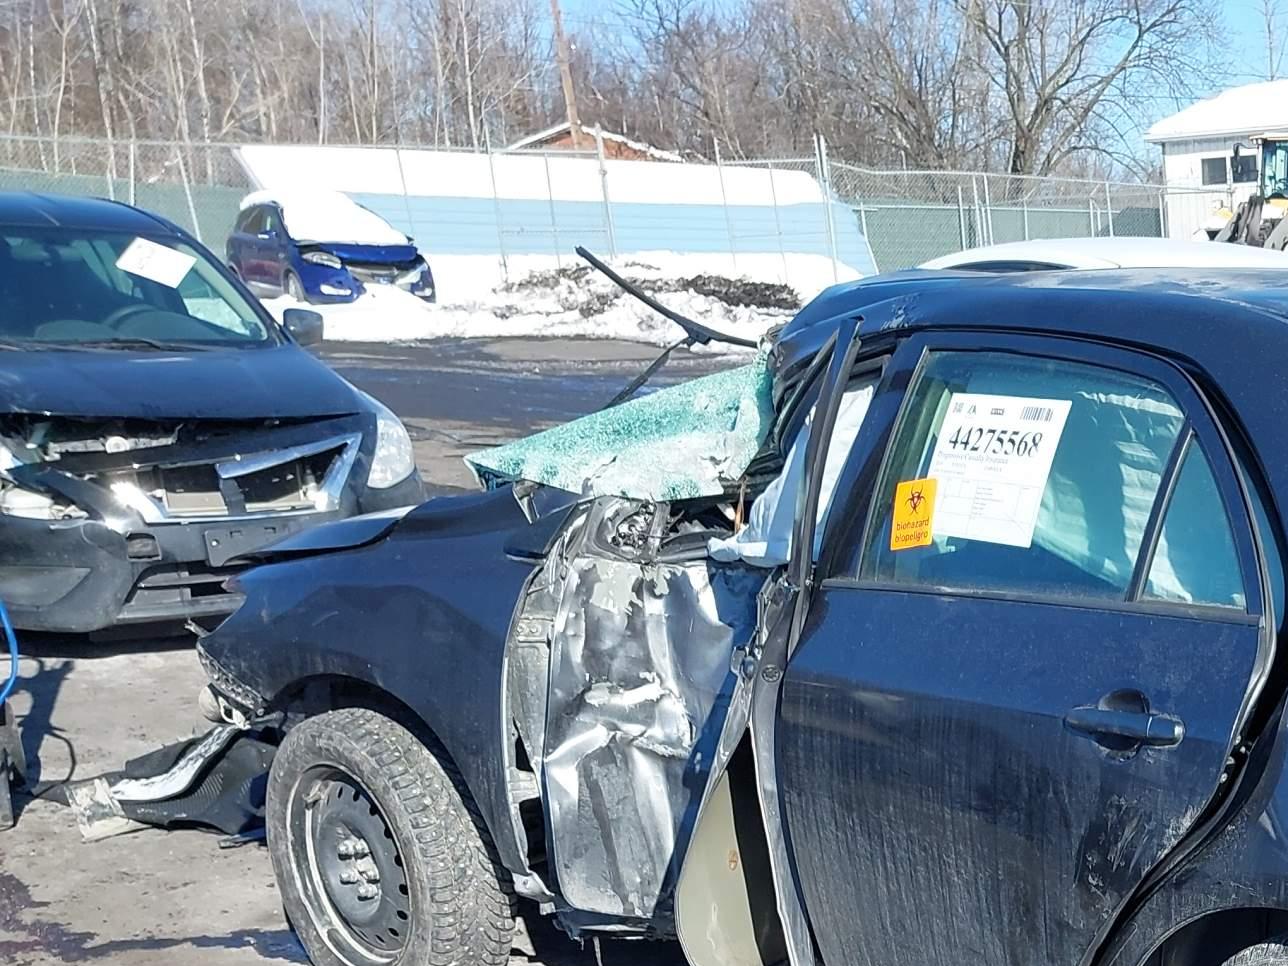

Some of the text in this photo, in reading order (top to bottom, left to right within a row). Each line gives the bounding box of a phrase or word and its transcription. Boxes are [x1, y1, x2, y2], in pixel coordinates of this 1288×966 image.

[949, 425, 1043, 458] 44275568
[897, 517, 930, 530] biohazard
[895, 531, 929, 544] biopeligro
